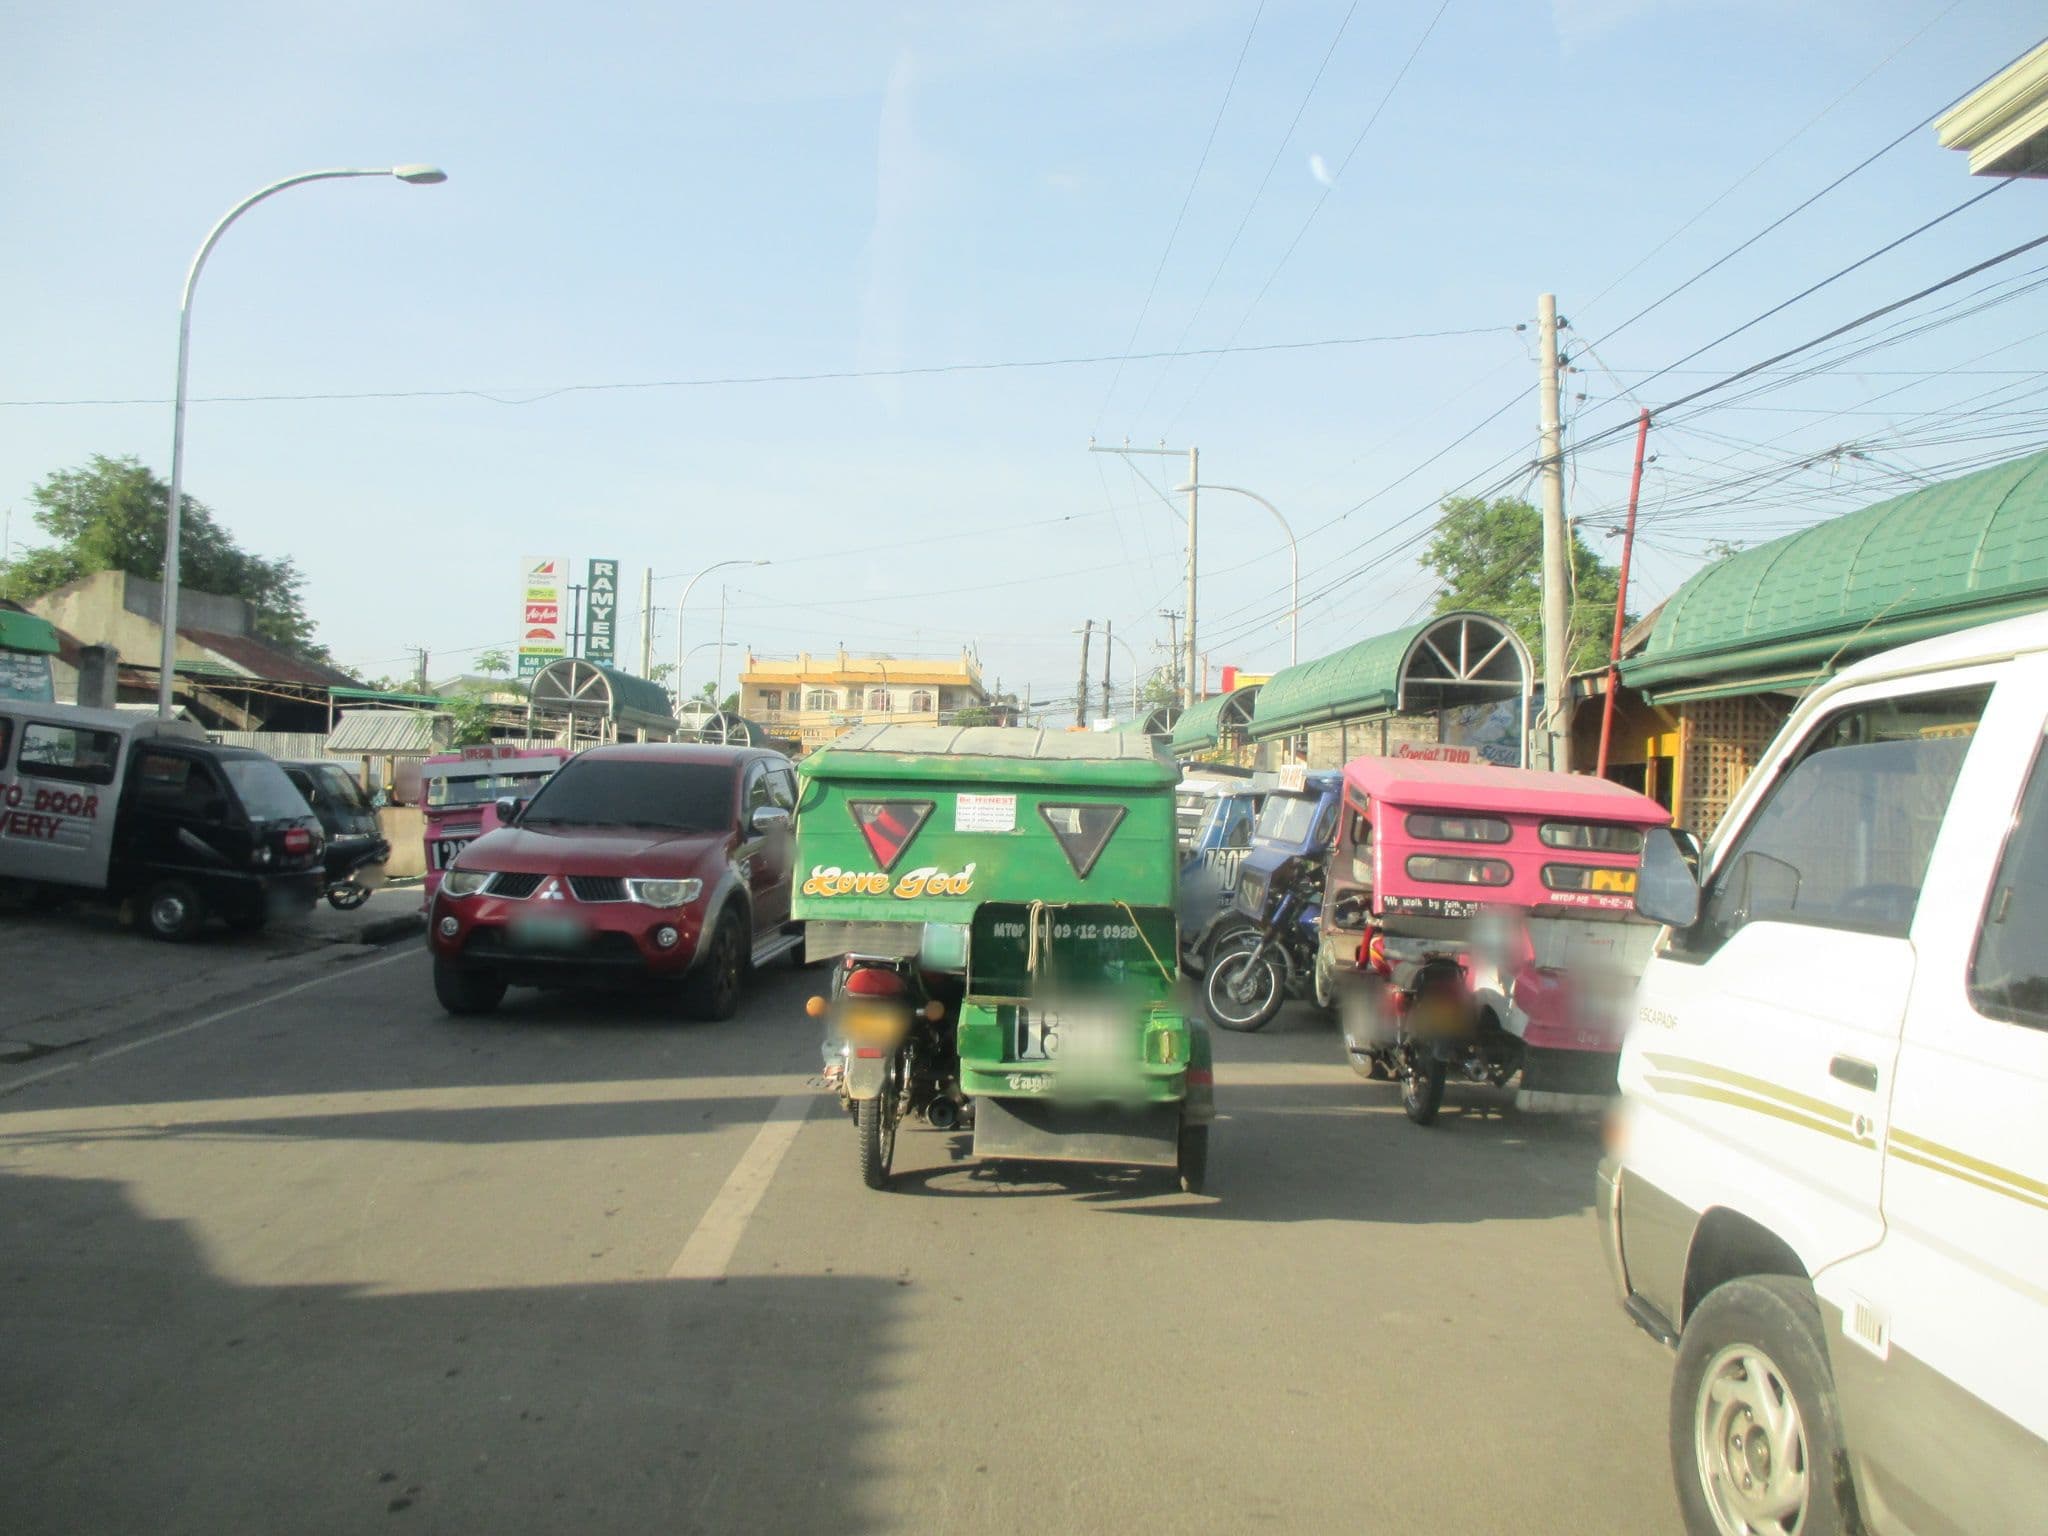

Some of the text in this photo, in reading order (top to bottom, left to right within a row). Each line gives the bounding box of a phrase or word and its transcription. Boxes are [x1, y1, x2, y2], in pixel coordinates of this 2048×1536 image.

[591, 562, 614, 650] RAMYER
[34, 788, 98, 818] DOOR
[803, 862, 976, 899] Love God
[1428, 899, 1440, 910] by
[994, 922, 1025, 938] MTOP
